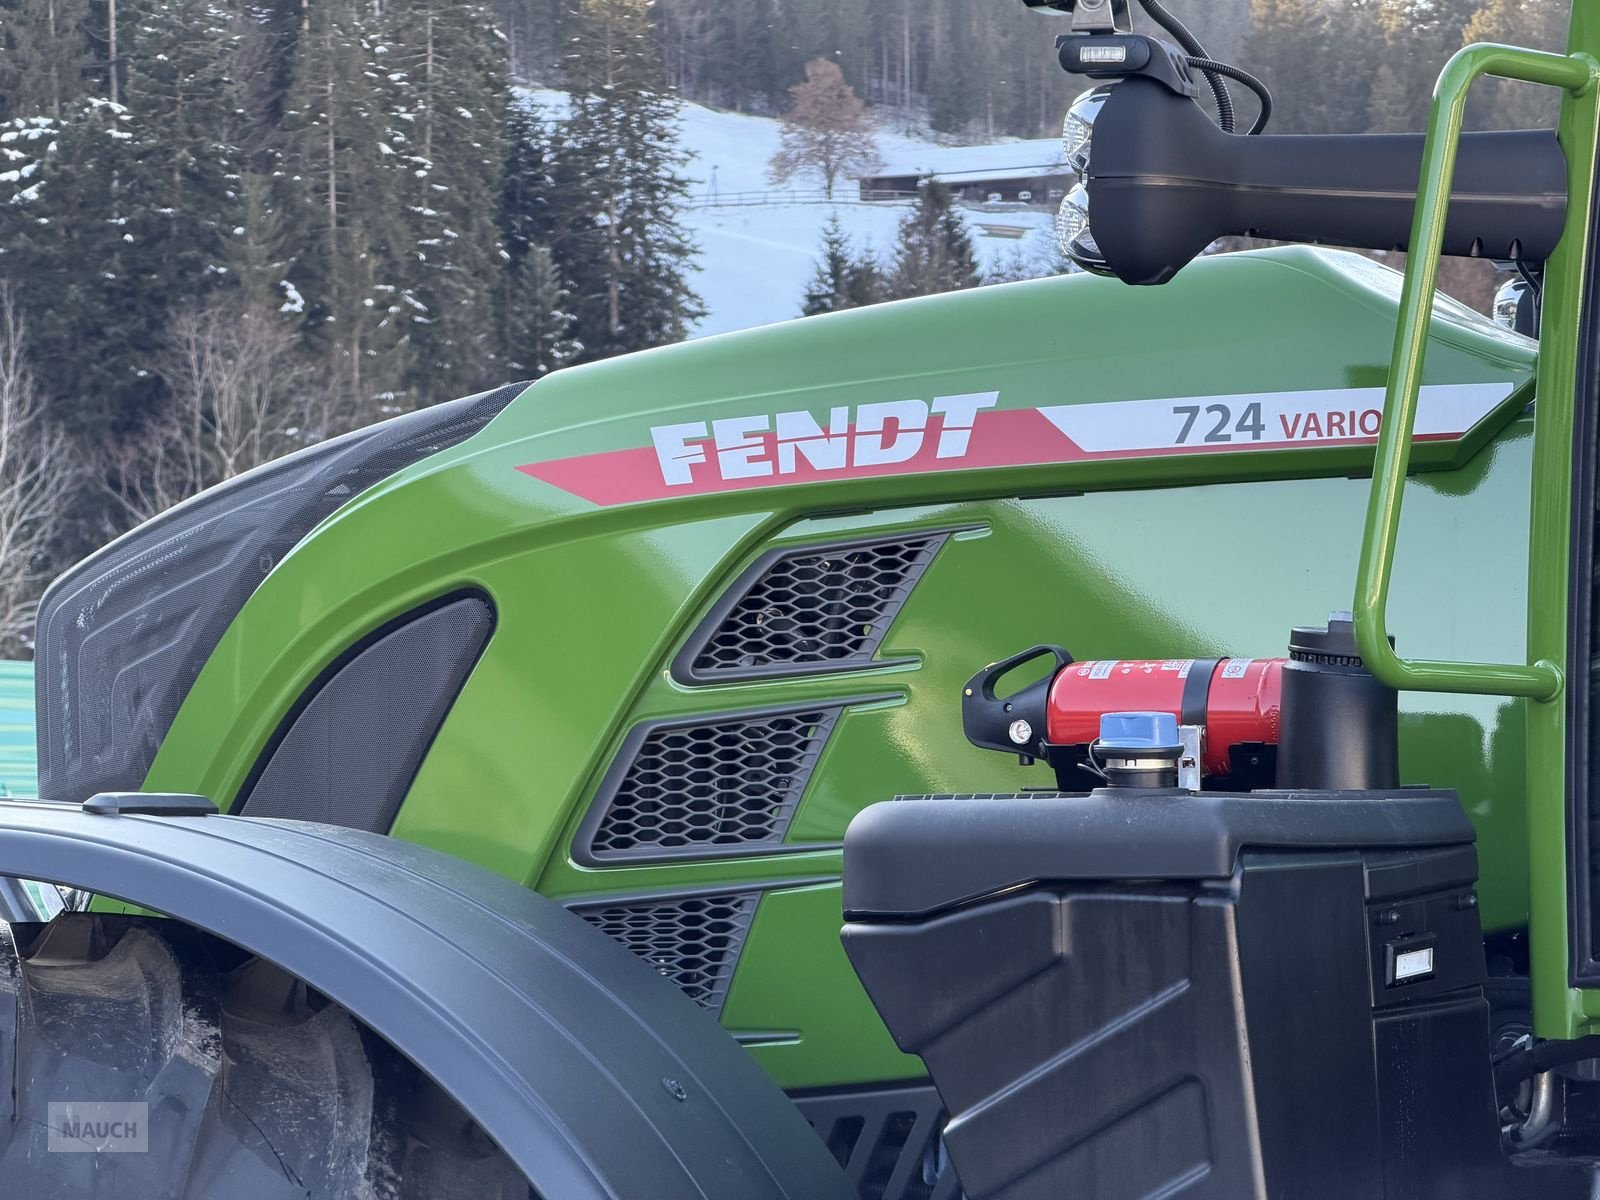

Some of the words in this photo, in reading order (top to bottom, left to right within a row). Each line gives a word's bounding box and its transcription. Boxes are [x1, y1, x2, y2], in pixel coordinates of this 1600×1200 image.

[650, 391, 1000, 486] FENDT
[1173, 402, 1266, 444] 724
[1279, 409, 1382, 439] VARIO
